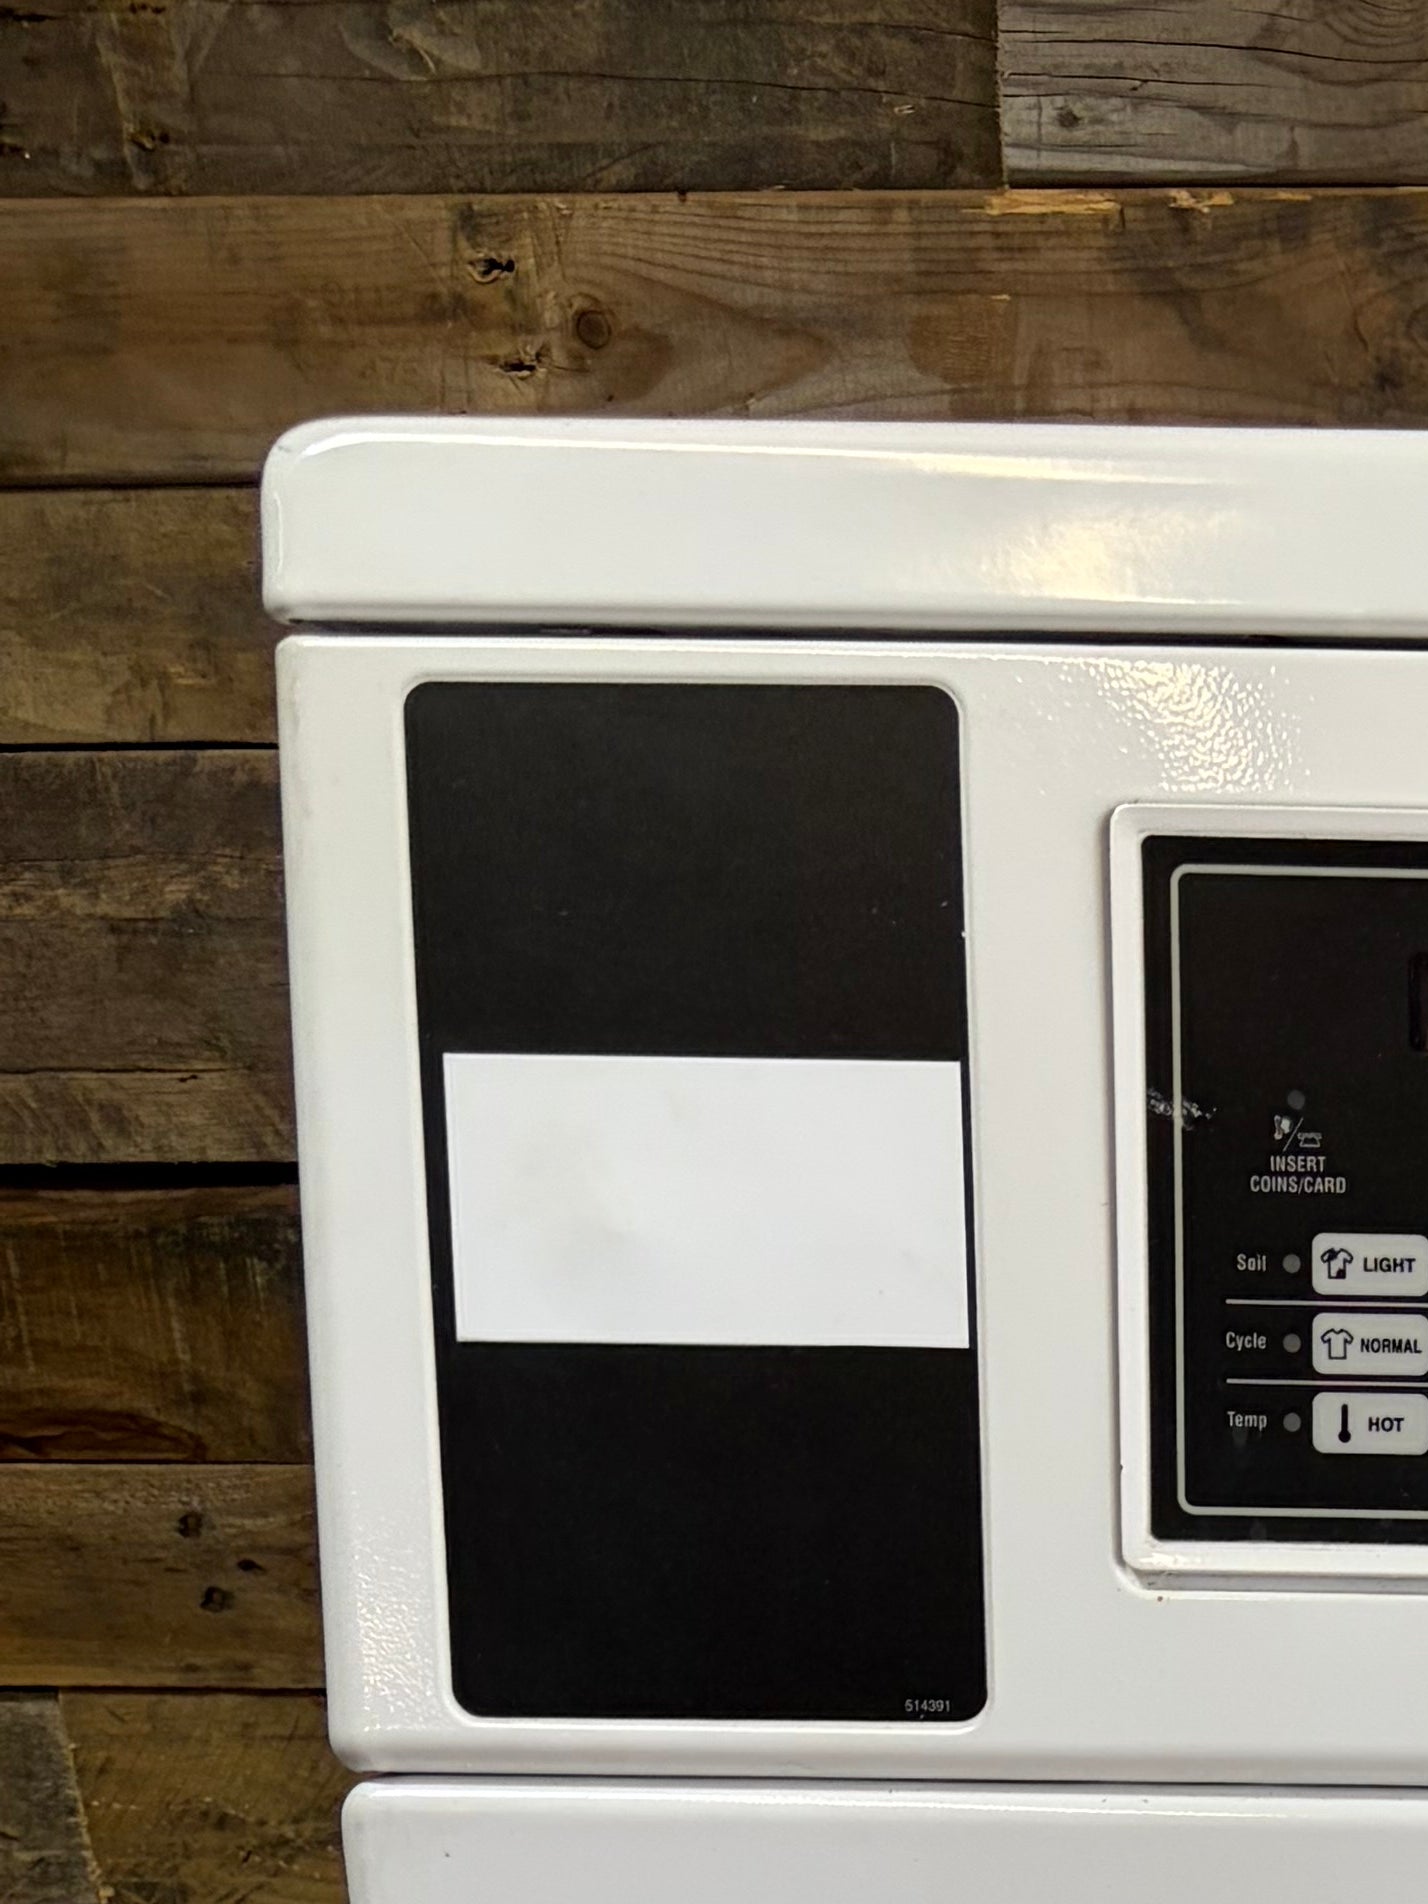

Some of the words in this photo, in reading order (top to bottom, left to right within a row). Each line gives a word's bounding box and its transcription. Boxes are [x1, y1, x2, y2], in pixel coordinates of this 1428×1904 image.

[1270, 1154, 1326, 1173] INSERT
[1250, 1175, 1347, 1194] COINS/CARD
[1363, 1256, 1417, 1273] LIGHT
[1225, 1331, 1267, 1352] Cycle
[1360, 1337, 1423, 1354] NORMAL
[1226, 1410, 1268, 1432] Temp
[1368, 1416, 1405, 1433] HOT
